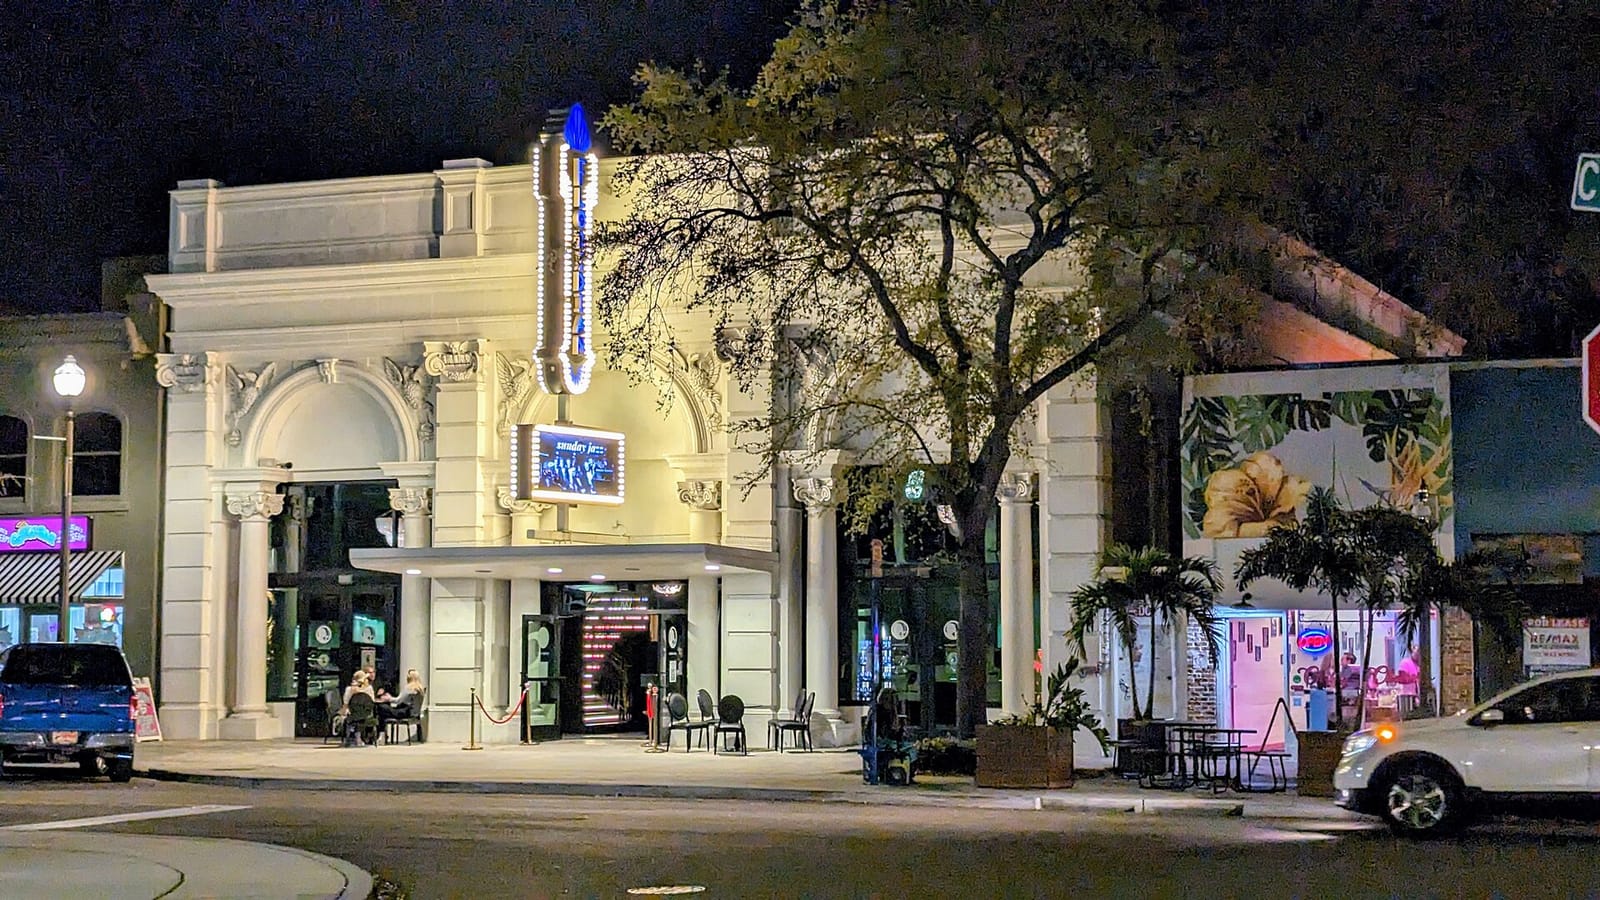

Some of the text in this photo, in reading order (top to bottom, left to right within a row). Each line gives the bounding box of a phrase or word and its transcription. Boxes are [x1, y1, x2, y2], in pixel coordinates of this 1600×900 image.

[556, 441, 605, 454] sunday jazz
[1297, 634, 1332, 649] OPEN
[1530, 634, 1579, 643] RE/MAX
